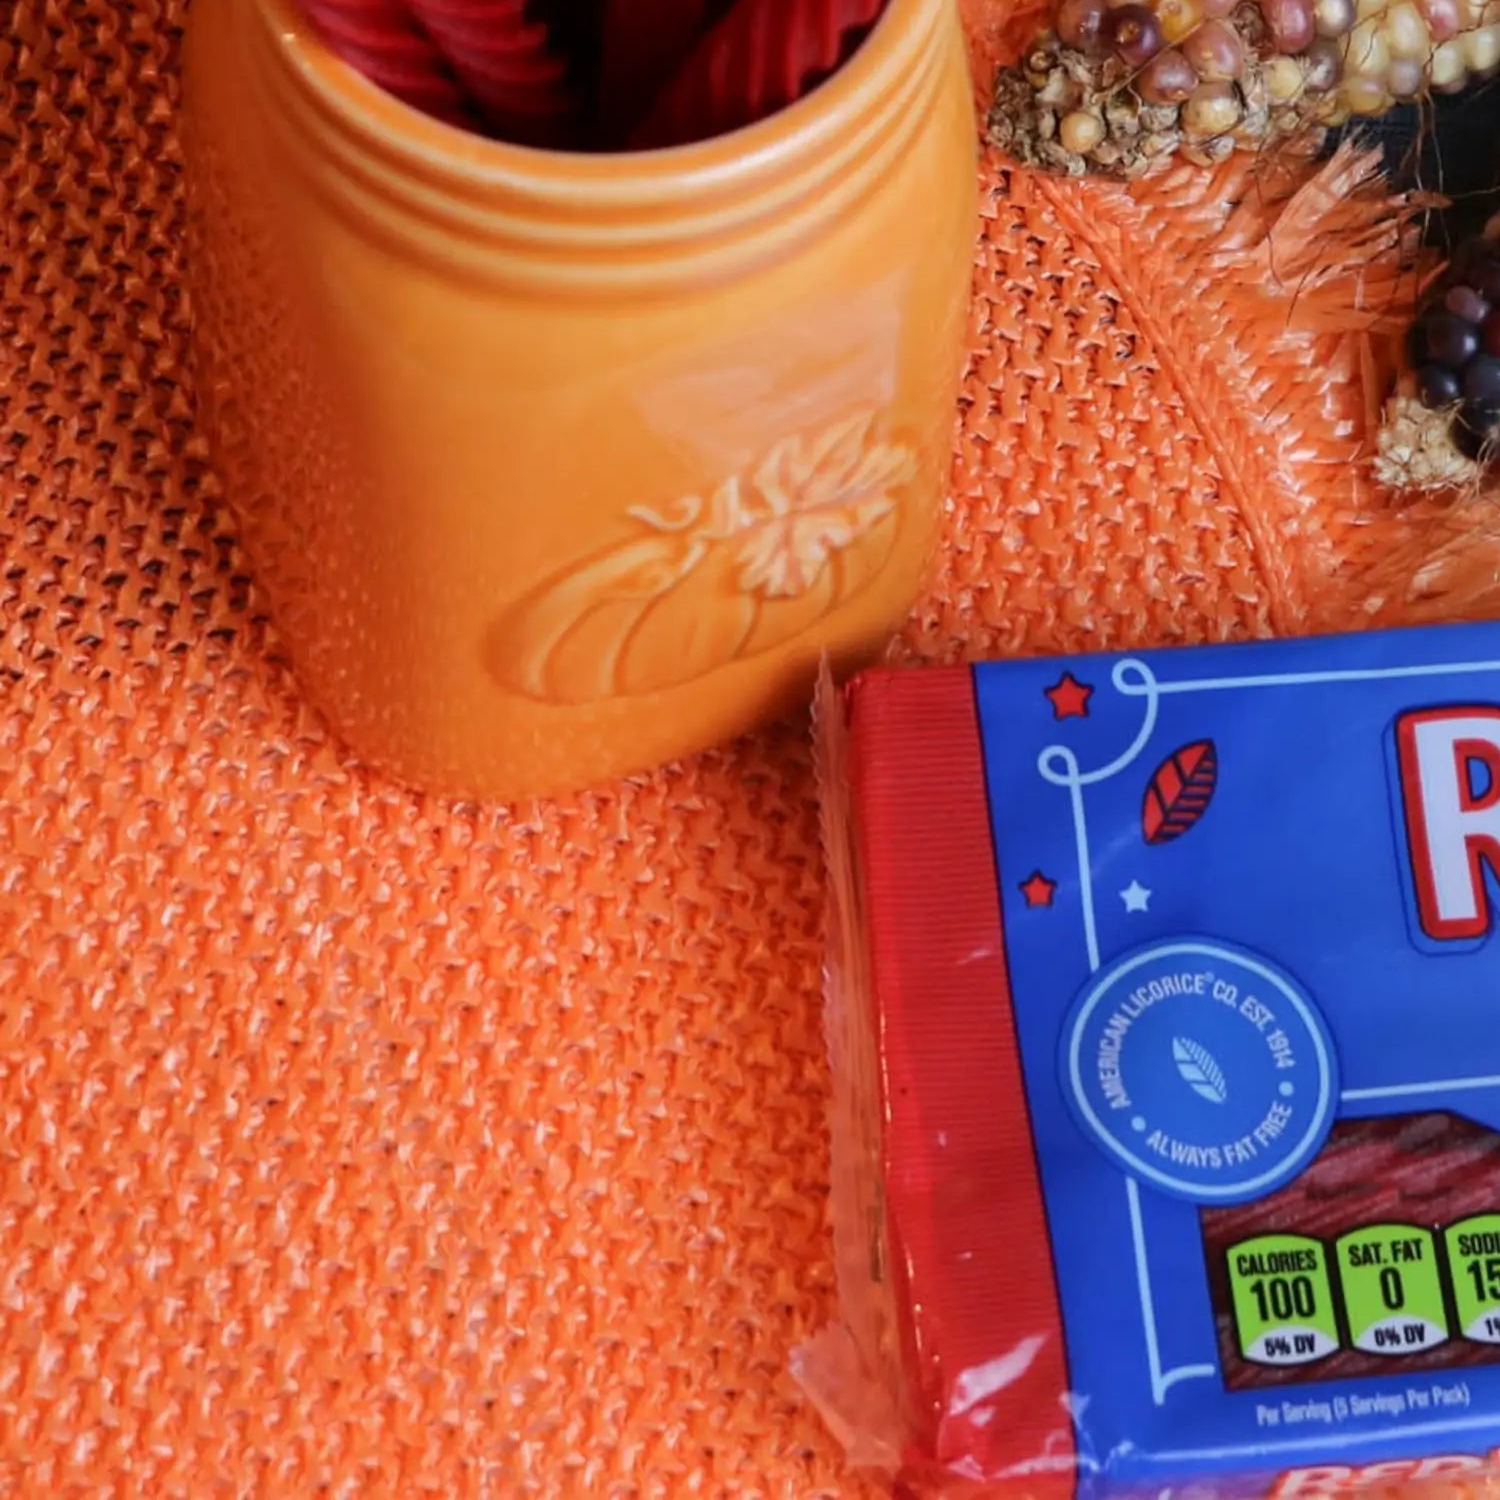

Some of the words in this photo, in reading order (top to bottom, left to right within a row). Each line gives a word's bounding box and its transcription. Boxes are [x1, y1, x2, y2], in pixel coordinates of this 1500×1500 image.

[1098, 1013, 1132, 1110] AMERICAN
[1266, 1029, 1296, 1069] 1914
[1146, 1129, 1222, 1169] ALWAYS
[1223, 1135, 1257, 1167] FAT
[1254, 1100, 1292, 1148] FREE
[1236, 1249, 1318, 1277] CALORIES
[1348, 1243, 1388, 1267] SAT.
[1396, 1239, 1423, 1262] FAT
[1250, 1275, 1316, 1322] 100
[1380, 1267, 1405, 1310] 0
[1264, 1337, 1291, 1357] 5%
[1294, 1333, 1316, 1354] DV
[1374, 1327, 1400, 1347] 0%
[1403, 1324, 1425, 1344] DV
[1257, 1404, 1279, 1426] Per
[1406, 1388, 1429, 1409] Per
